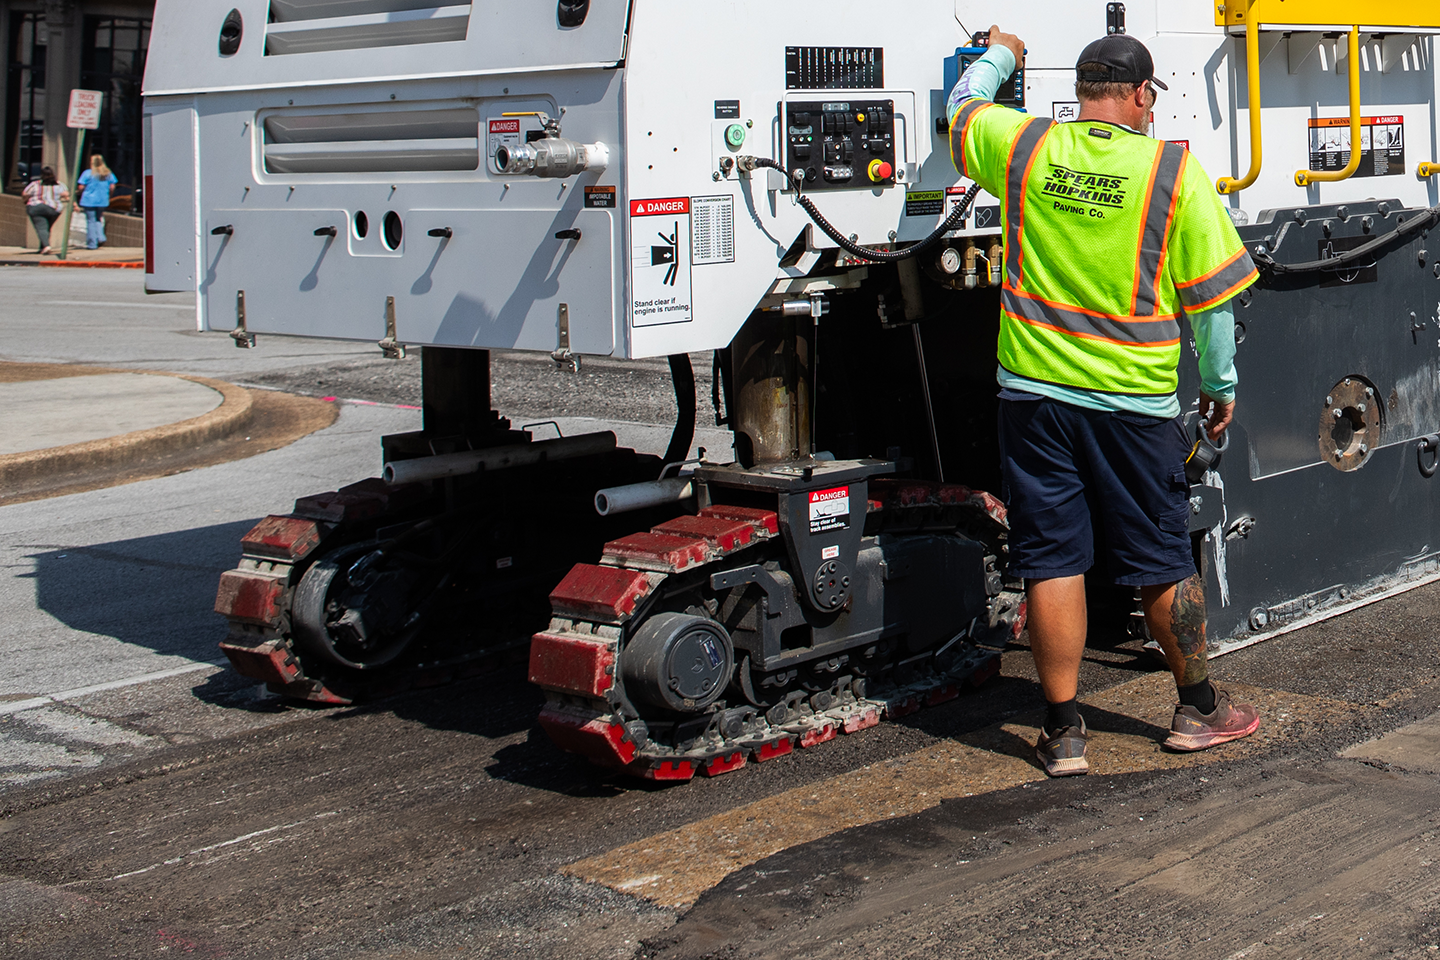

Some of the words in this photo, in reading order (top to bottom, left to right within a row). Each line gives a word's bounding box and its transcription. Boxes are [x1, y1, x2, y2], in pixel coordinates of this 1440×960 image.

[496, 122, 517, 130] DANGER
[1052, 168, 1121, 189] SPEARS
[1044, 181, 1124, 204] HOPKINS
[648, 202, 684, 212] DANGER
[634, 300, 653, 308] Stand
[634, 307, 656, 316] engine
[664, 304, 690, 313] running.
[820, 490, 846, 500] DANGER
